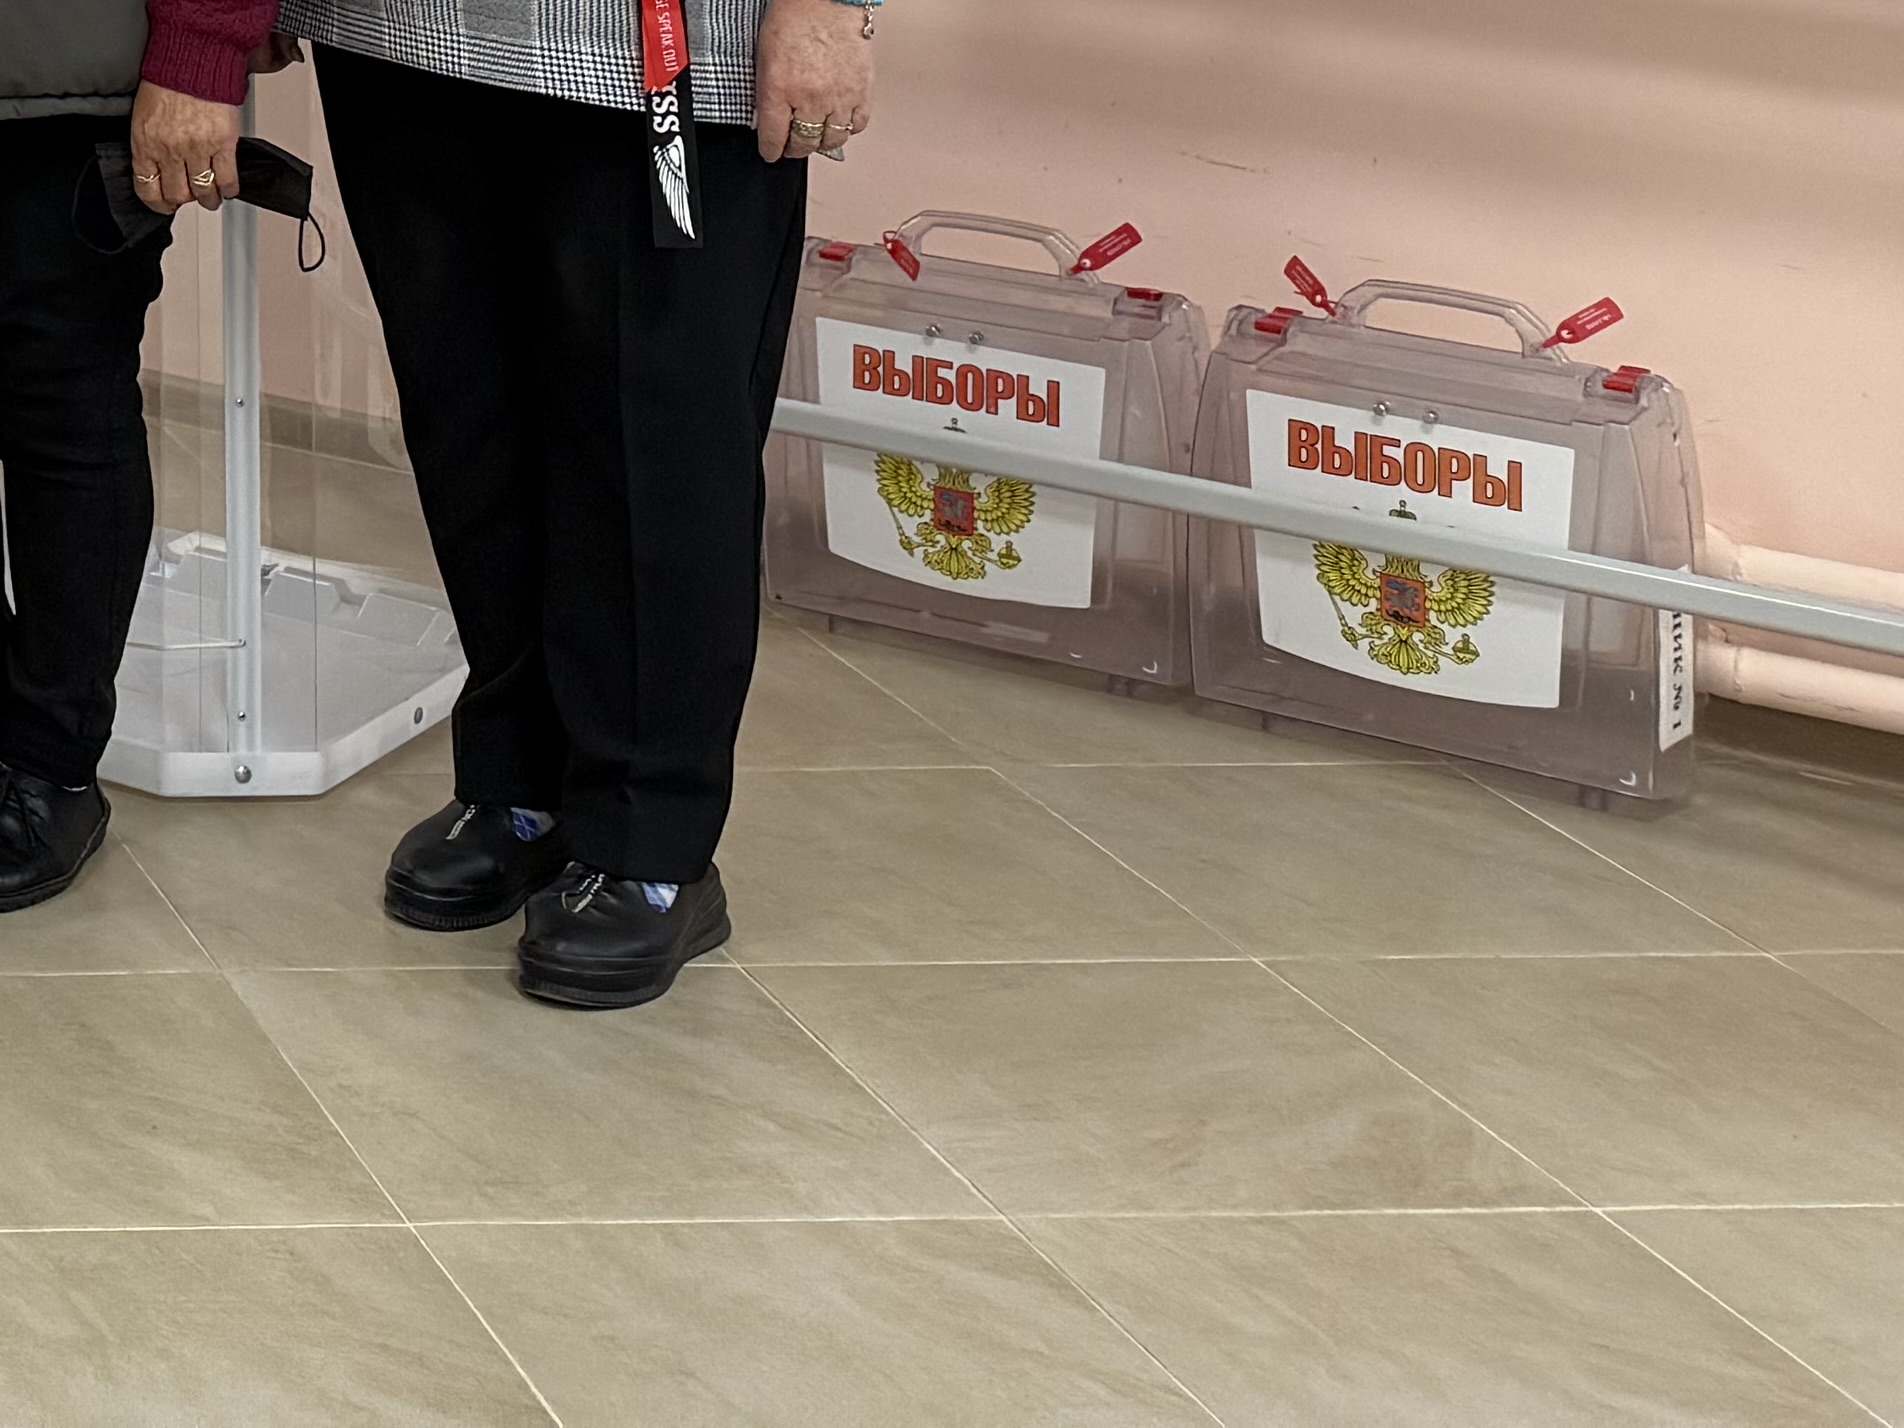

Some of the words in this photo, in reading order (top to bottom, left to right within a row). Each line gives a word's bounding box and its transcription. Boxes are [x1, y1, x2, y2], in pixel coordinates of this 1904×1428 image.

[657, 11, 677, 51] SPEAK
[663, 51, 679, 72] OUT
[852, 343, 1061, 428] ВЫБОРЫ
[1287, 417, 1523, 512] ВЫБОРЫ
